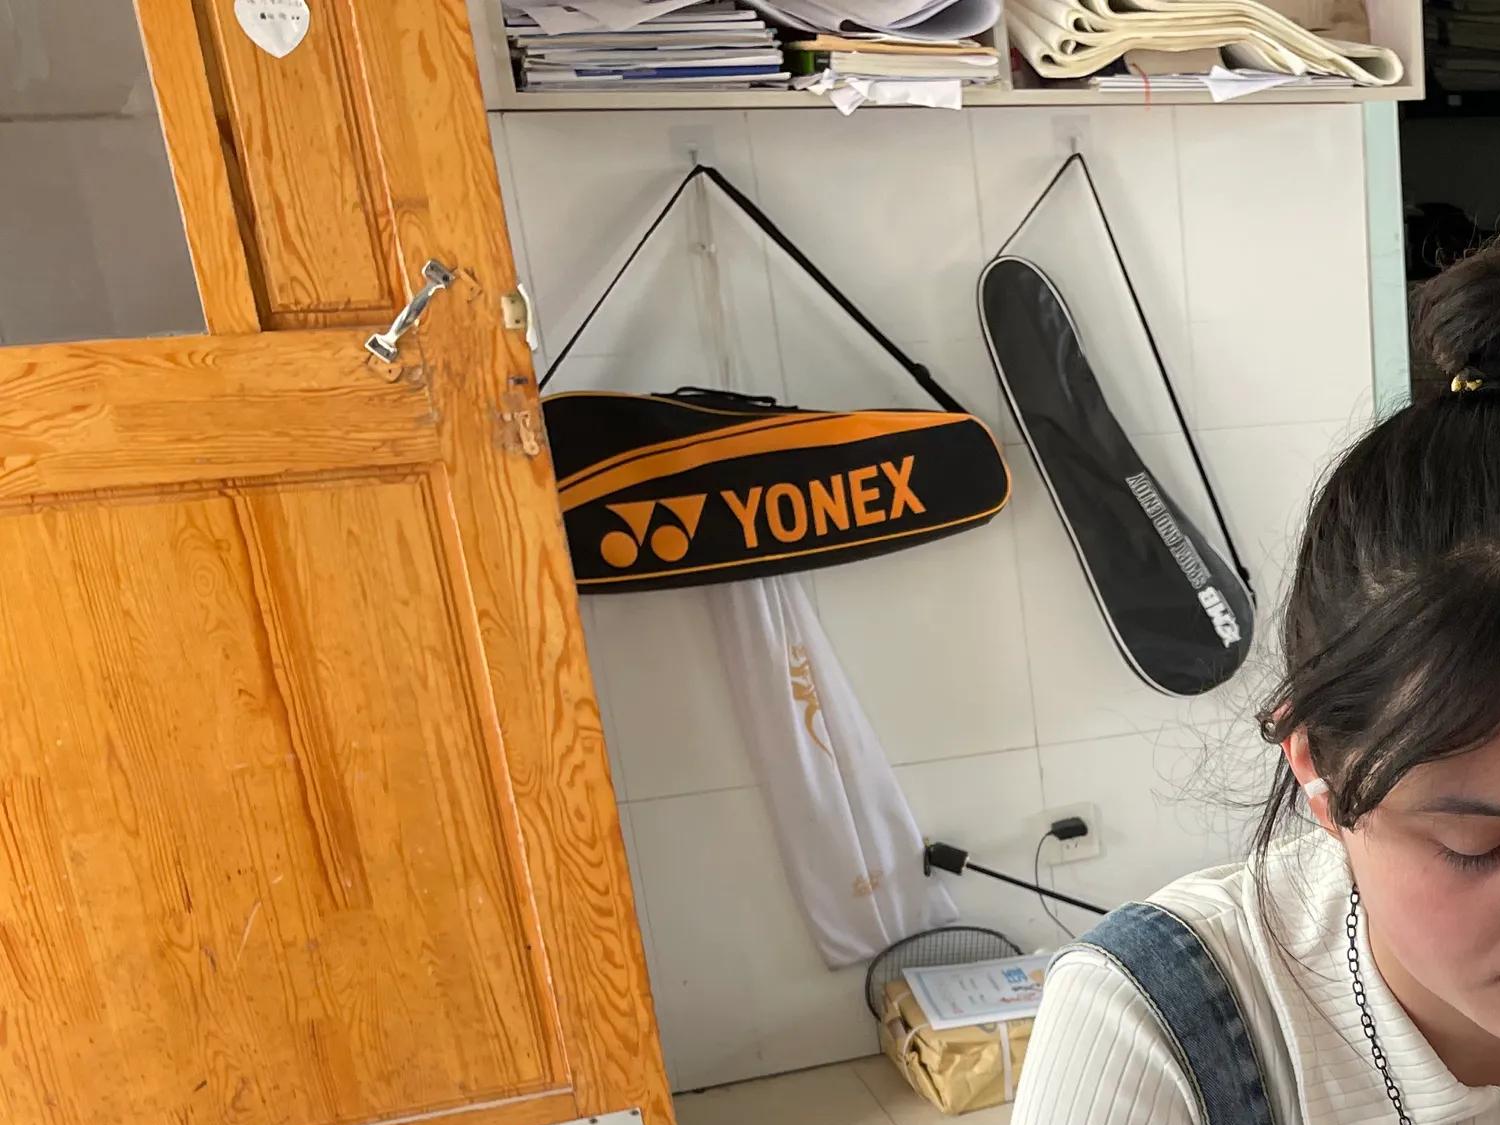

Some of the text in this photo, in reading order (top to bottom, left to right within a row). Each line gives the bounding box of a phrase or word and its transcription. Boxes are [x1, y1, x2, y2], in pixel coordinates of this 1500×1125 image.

[720, 455, 927, 549] YONEX
[1125, 471, 1166, 514] ENJOY
[1152, 513, 1182, 546] AND
[1170, 539, 1210, 588] SPORT
